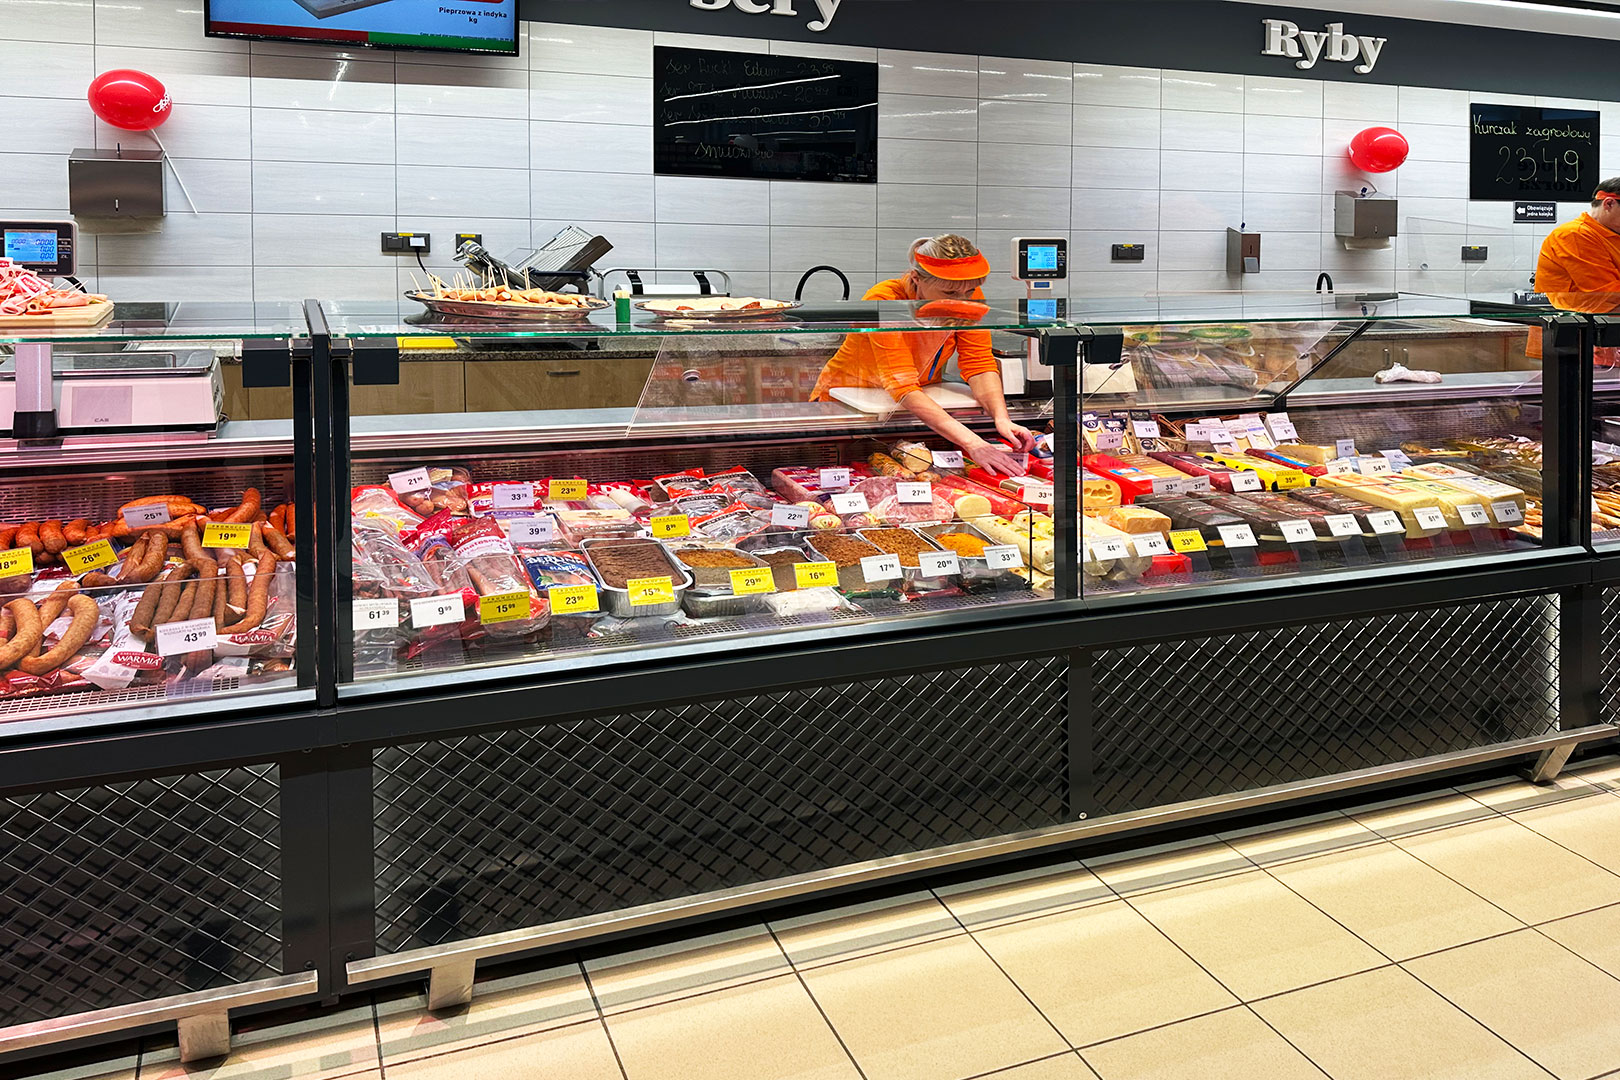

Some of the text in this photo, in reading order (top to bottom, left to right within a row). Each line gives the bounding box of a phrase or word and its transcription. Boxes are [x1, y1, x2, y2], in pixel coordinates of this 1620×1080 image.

[438, 6, 476, 15] Pieprzowa
[483, 10, 507, 18] indyka
[468, 16, 478, 24] kg
[1261, 18, 1387, 74] Ryby
[1472, 113, 1593, 148] Kurczak zagrodowy
[117, 655, 161, 666] WARMIA
